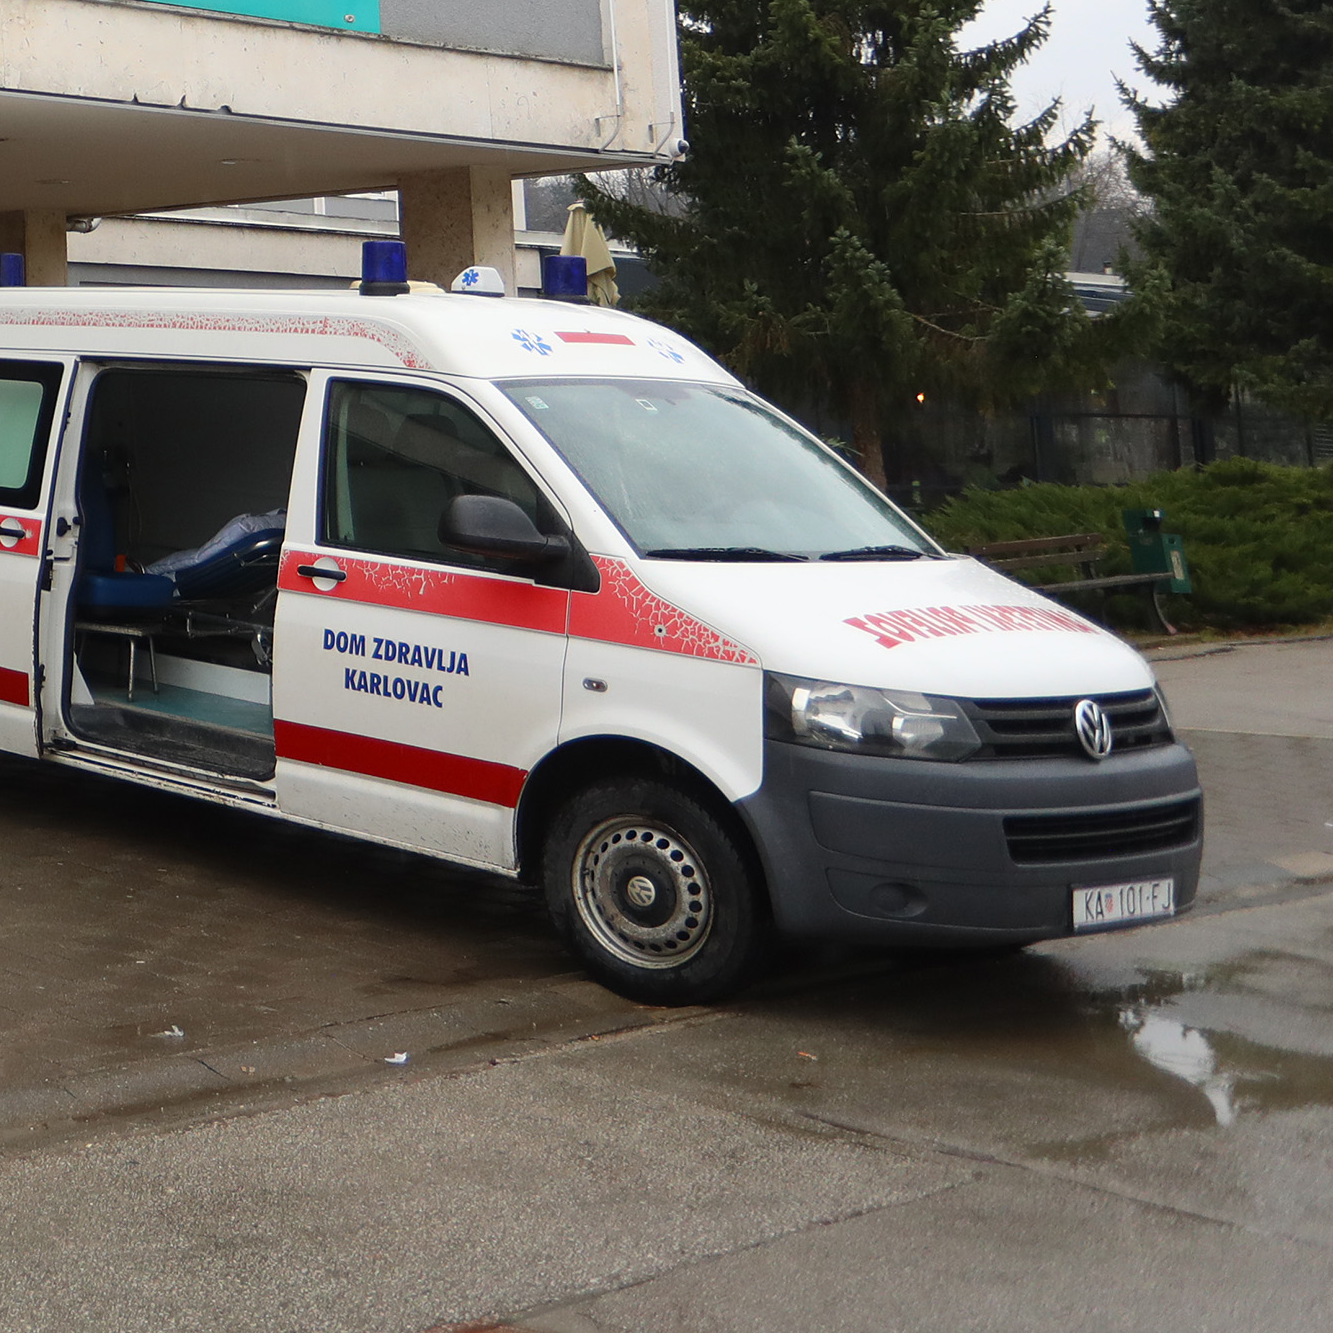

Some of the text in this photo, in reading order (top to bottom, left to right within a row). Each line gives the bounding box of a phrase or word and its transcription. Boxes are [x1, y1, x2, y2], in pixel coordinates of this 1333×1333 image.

[323, 628, 470, 677] DOM ZDRAVLJA
[344, 667, 444, 709] KARLOVAC
[1084, 890, 1105, 921] KA
